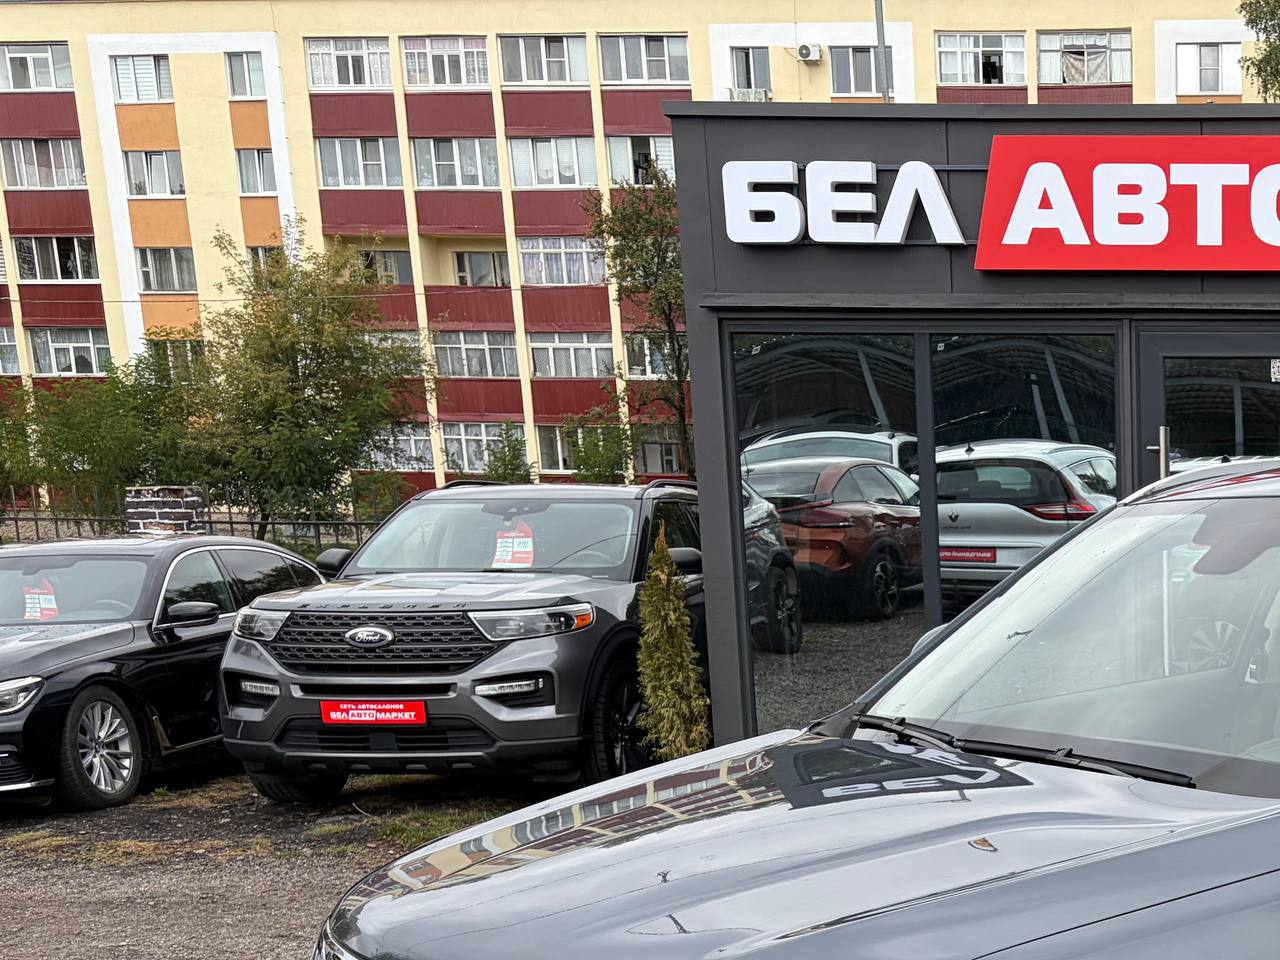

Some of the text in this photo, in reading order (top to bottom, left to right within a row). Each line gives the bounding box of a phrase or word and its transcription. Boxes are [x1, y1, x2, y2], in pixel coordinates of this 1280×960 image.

[722, 159, 966, 245] БЕЛ
[355, 631, 380, 642] Ford
[330, 711, 416, 720] БЕЛ АВТО МАРКЕТ
